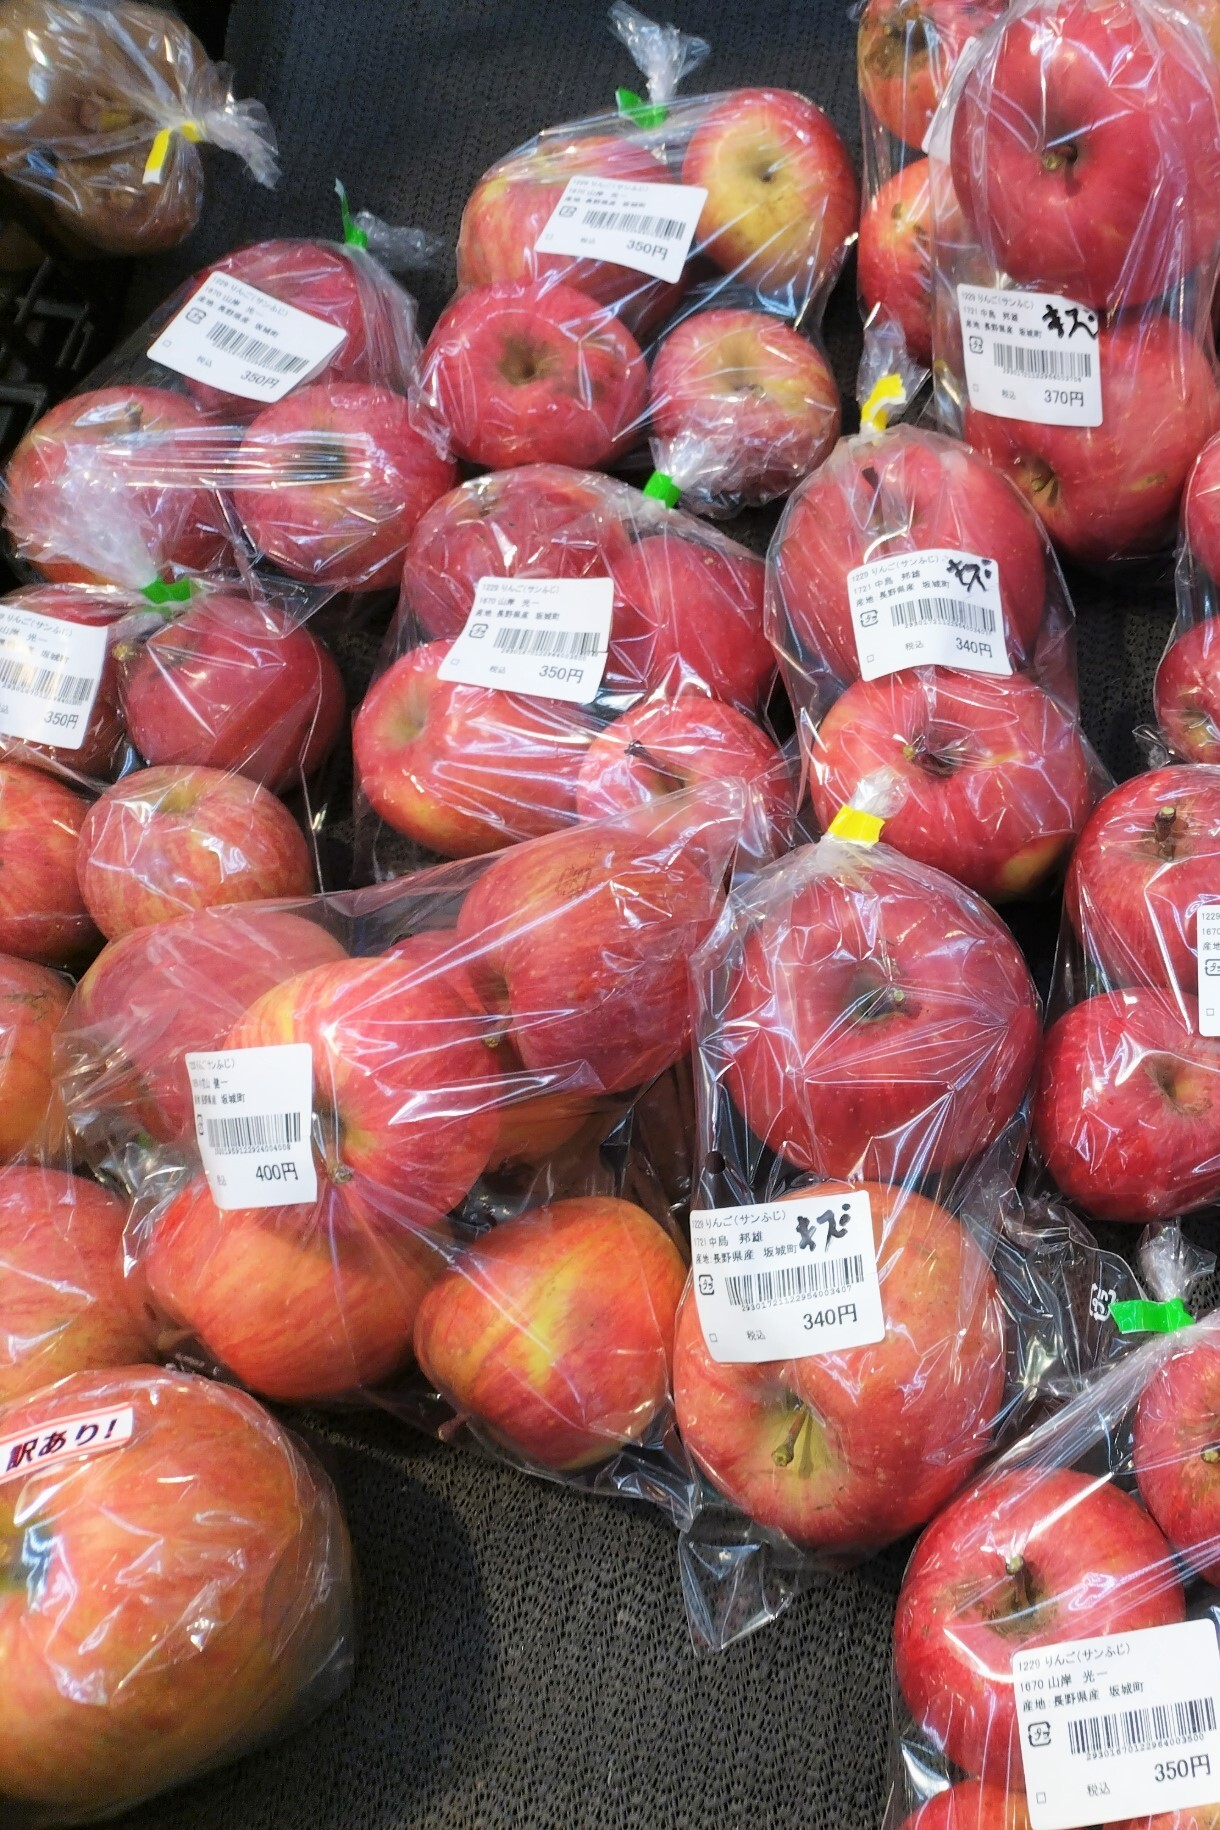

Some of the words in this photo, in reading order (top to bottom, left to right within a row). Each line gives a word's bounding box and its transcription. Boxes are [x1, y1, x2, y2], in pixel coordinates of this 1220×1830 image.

[626, 239, 668, 260] 350円
[240, 370, 280, 389] 350円
[1044, 390, 1084, 407] 370円
[853, 583, 872, 595] 1721
[955, 637, 993, 658] 340円
[539, 665, 584, 684] 350円
[44, 711, 79, 729] 350円
[1201, 912, 1220, 920] 1229
[255, 1162, 299, 1182] 400円
[705, 1209, 787, 1228] りんご(サンふじ)
[694, 1236, 707, 1247] 1721
[709, 1233, 729, 1247] 中島
[739, 1231, 763, 1244] 邦雄
[763, 1244, 798, 1258] 坂城町
[741, 1285, 853, 1312] 29301721122954003407
[746, 1330, 766, 1341] 税込
[802, 1302, 858, 1330] 340円
[1044, 1642, 1131, 1666] りんご(サンふじ)
[1020, 1680, 1044, 1693] 1670
[1048, 1673, 1072, 1689] 山岸
[1083, 1670, 1109, 1684] 光一
[1086, 1782, 1111, 1798] 税込
[1153, 1753, 1212, 1783] 350円
